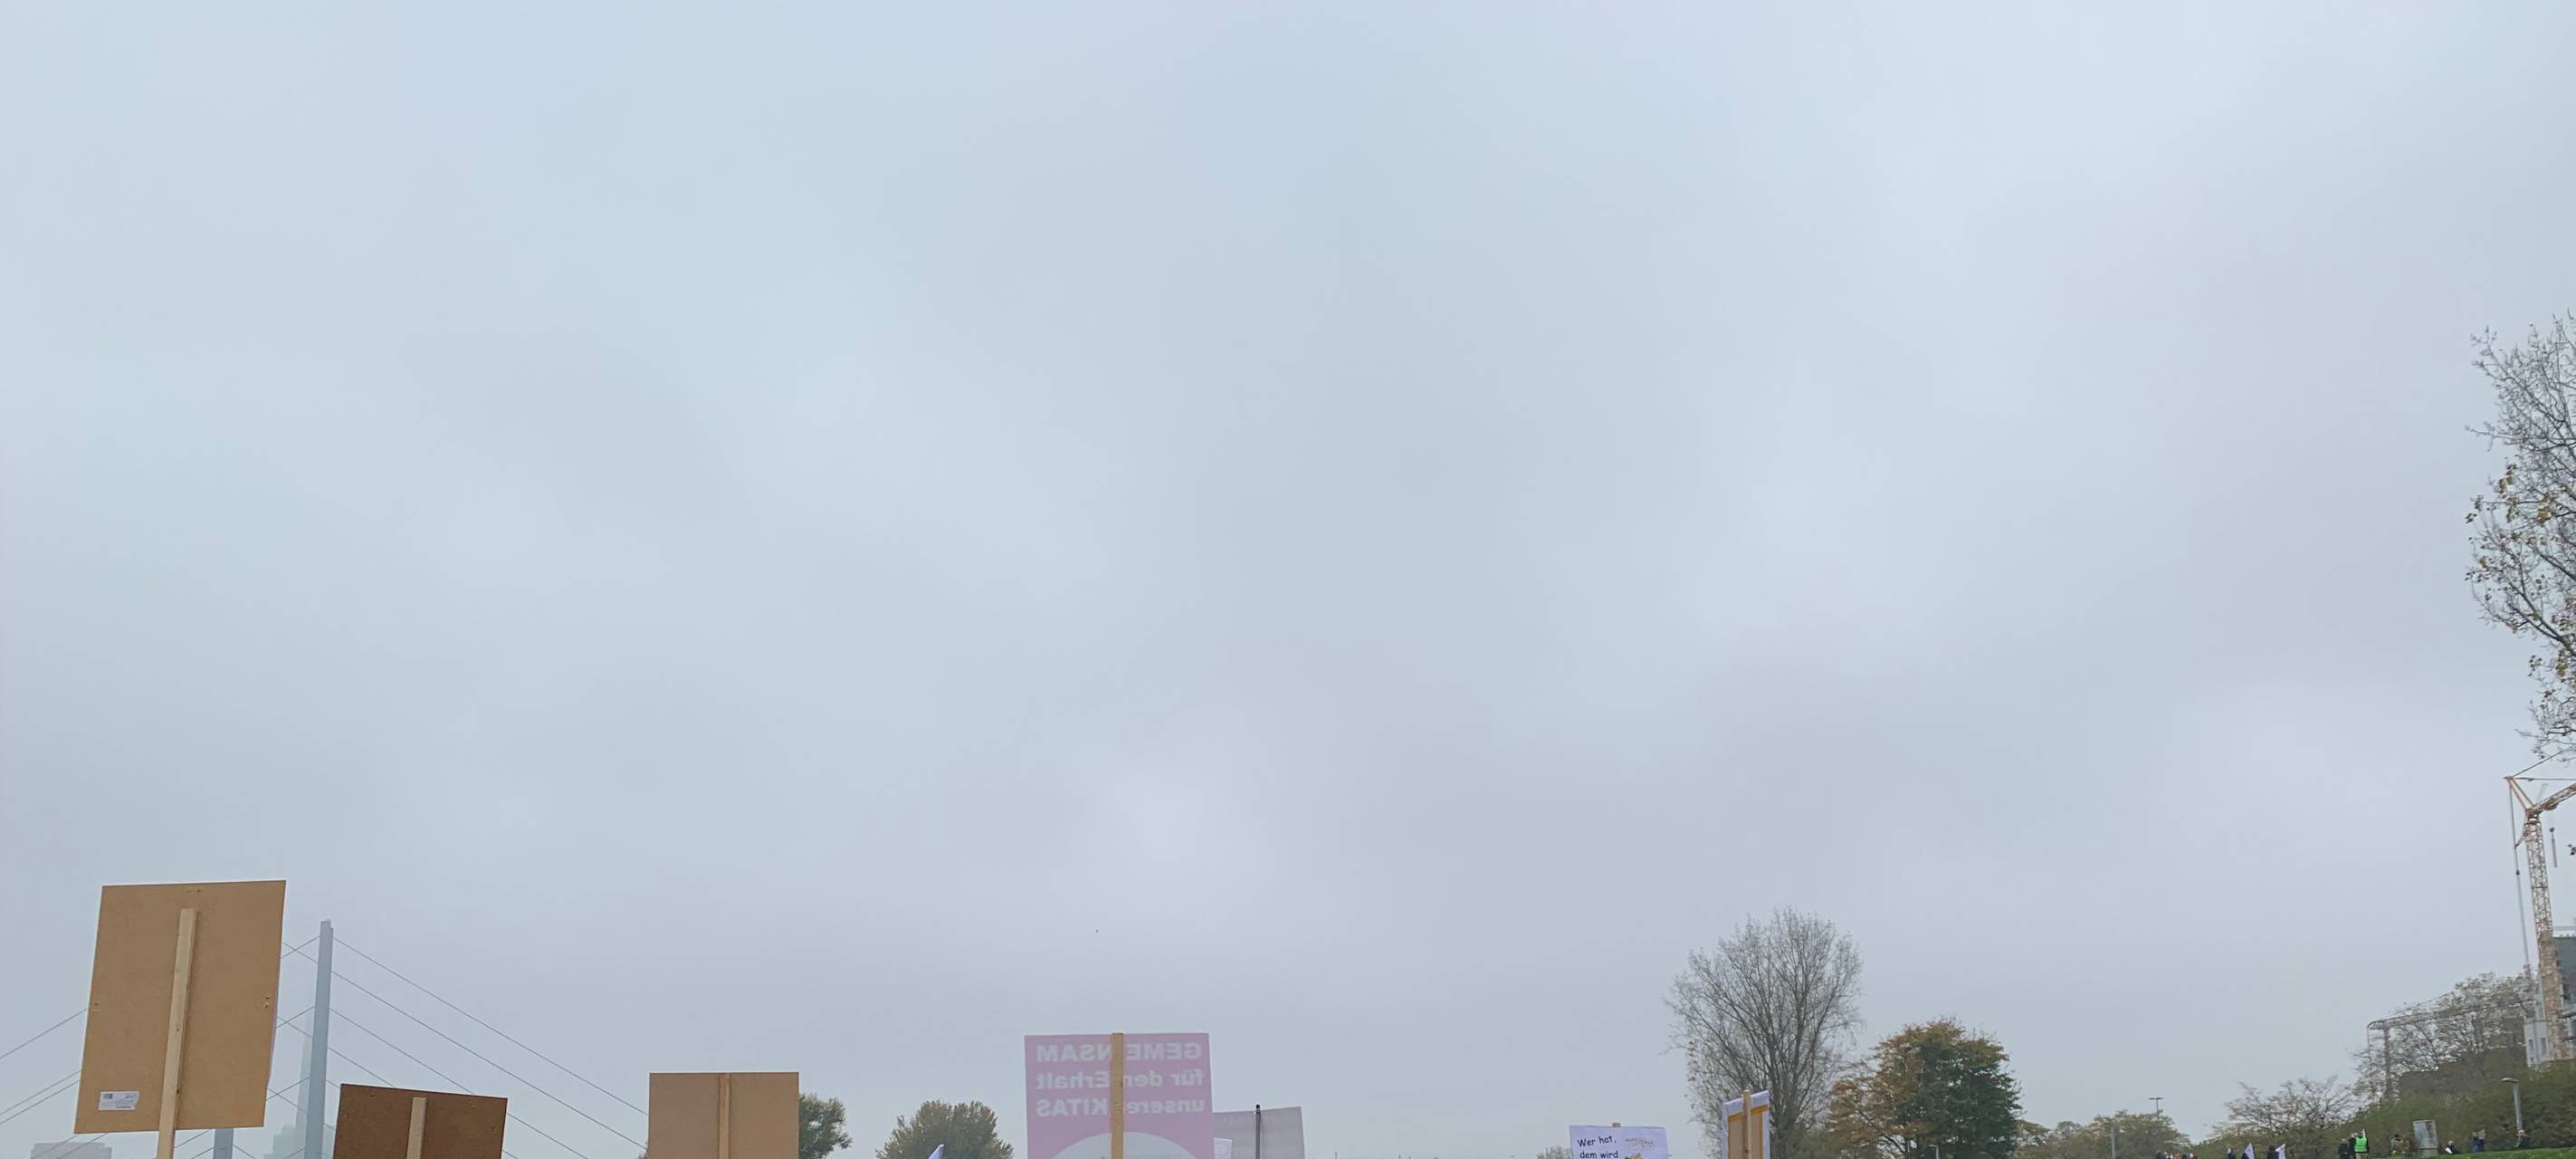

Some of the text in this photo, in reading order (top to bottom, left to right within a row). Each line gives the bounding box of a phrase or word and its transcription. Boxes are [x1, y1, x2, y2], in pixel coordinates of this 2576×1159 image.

[1577, 1138, 1596, 1147] Wer
[1579, 1150, 1618, 1159] dem wird
